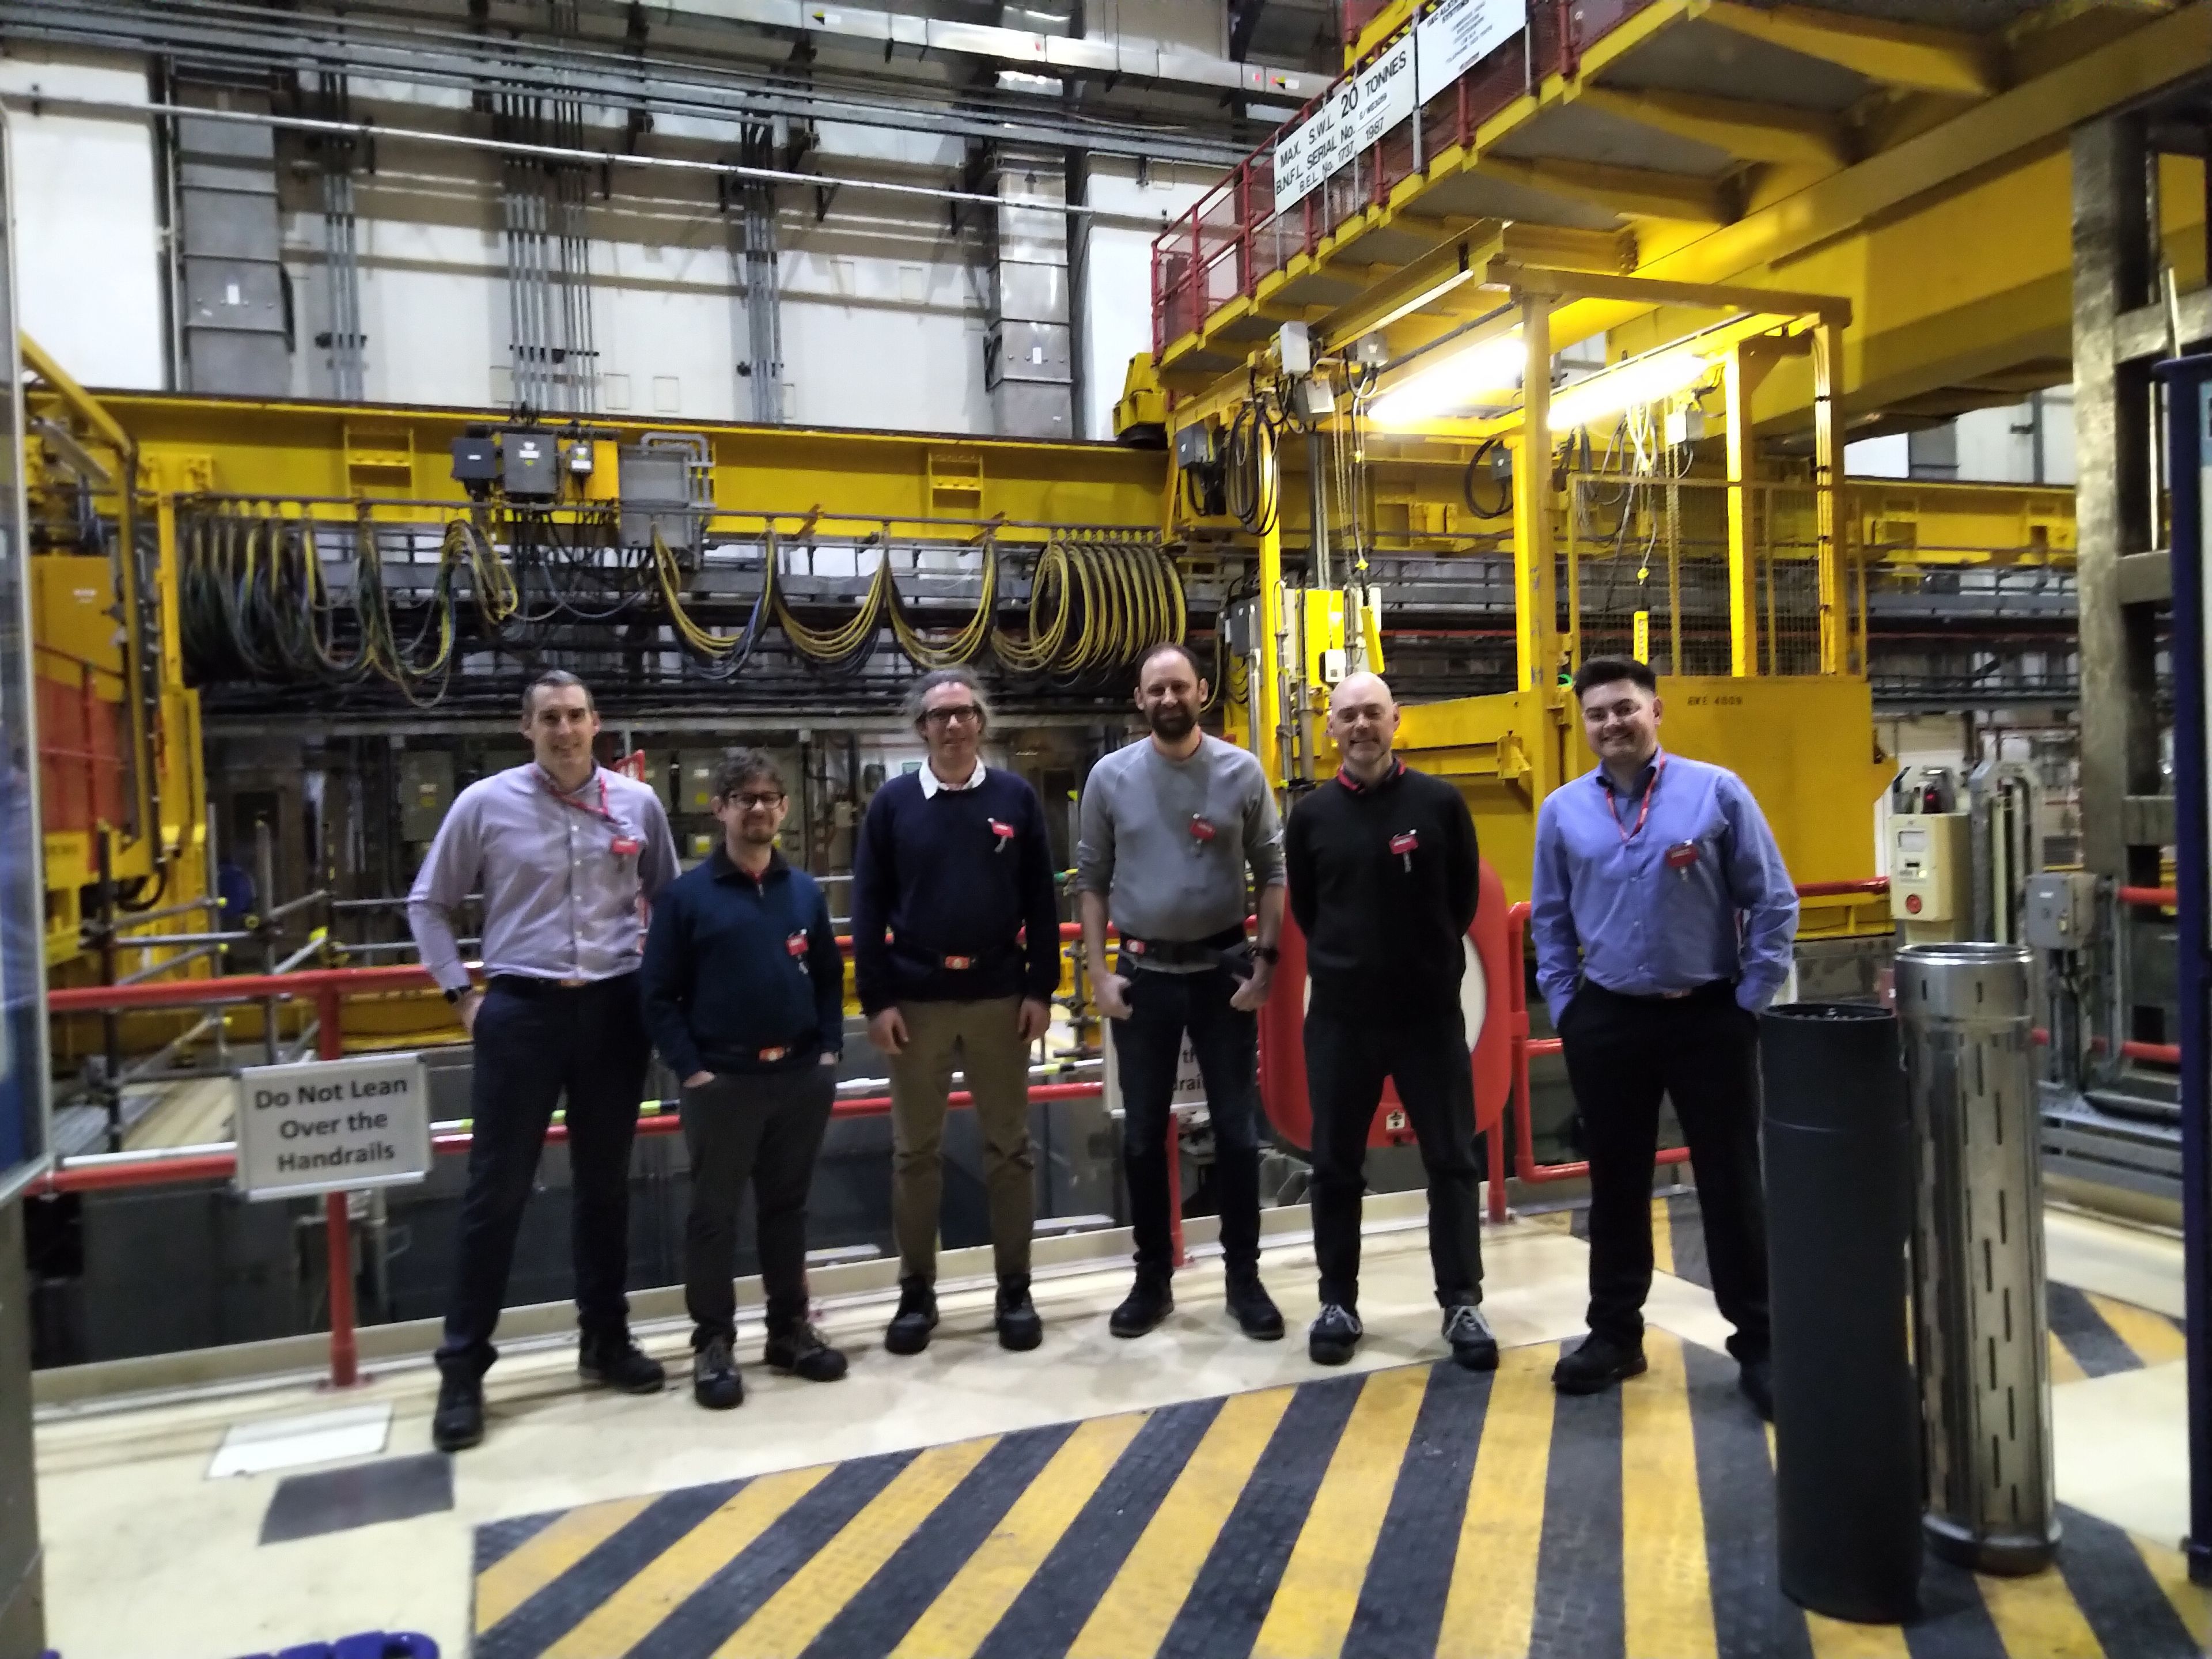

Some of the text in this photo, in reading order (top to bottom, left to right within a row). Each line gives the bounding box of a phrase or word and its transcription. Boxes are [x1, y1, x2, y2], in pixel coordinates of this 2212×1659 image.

[1341, 86, 1358, 119] 20
[1365, 51, 1406, 97] TONNES
[1365, 116, 1384, 141] 1987
[1307, 136, 1337, 171] SERIAL
[255, 1078, 407, 1109] Do Not Lean
[280, 1112, 388, 1139] Over the
[277, 1141, 395, 1172] Handrails
